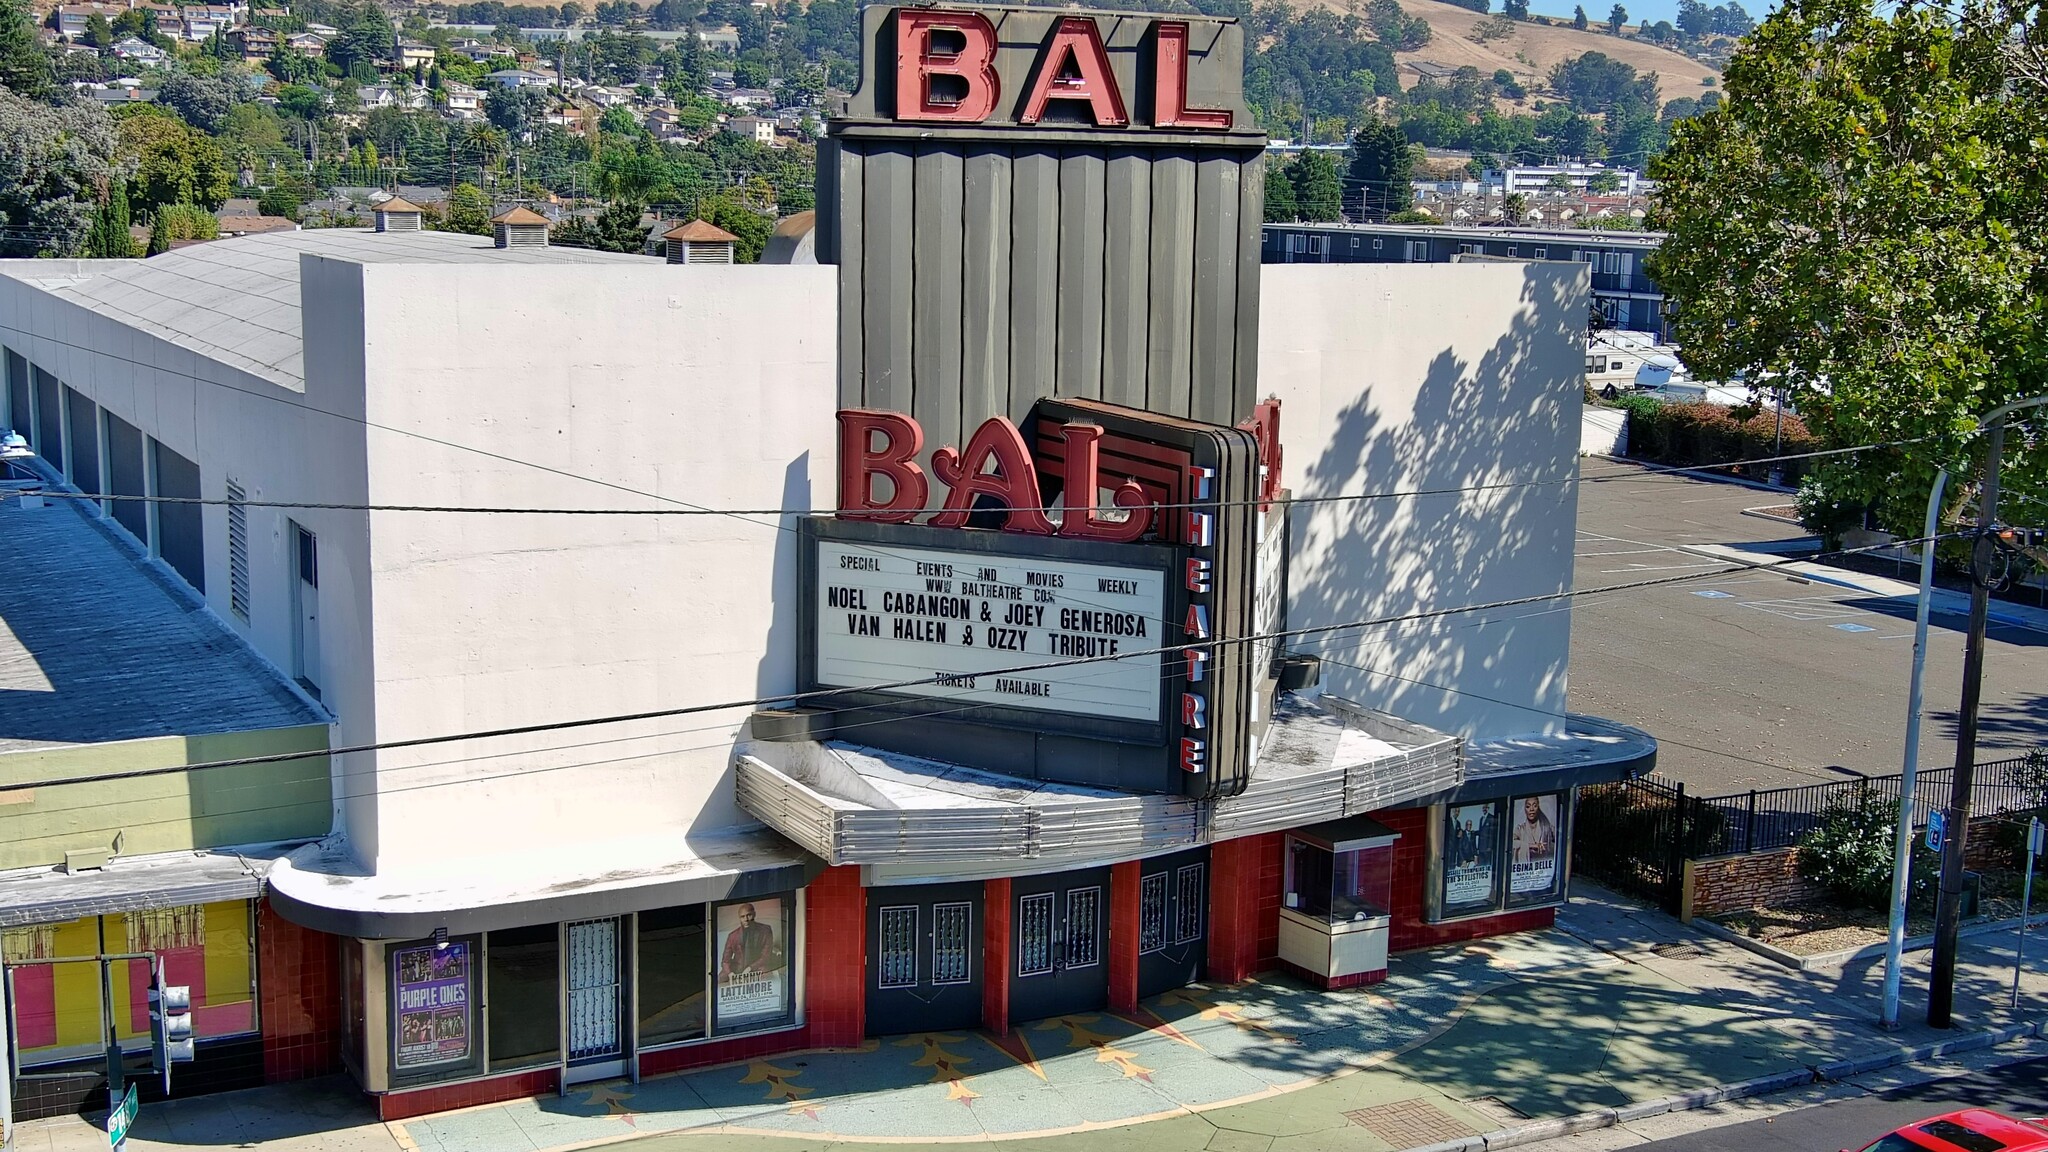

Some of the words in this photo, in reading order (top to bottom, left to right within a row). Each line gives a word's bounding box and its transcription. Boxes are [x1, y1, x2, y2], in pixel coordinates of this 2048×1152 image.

[897, 8, 1233, 128] BAL
[836, 410, 1154, 542] BAL
[840, 555, 880, 571] SPECIAL
[917, 561, 953, 578] EVENTS
[977, 567, 997, 582] AND
[1026, 571, 1064, 588] MOVIES
[1098, 578, 1138, 595] WEEKLY
[962, 582, 1022, 600] BALTHEATRE
[828, 586, 867, 610] NOEL
[883, 591, 970, 619] CABANGON
[980, 601, 992, 622] &
[1004, 603, 1045, 627] JOEY
[1060, 607, 1147, 637] GENEROSA
[1180, 466, 1214, 773] THEATRE
[847, 613, 880, 637] VAN
[893, 617, 947, 643] HALEN
[987, 626, 1028, 651] OZZY
[1048, 633, 1118, 660] TRIBUTE
[935, 672, 976, 689] TICKETS
[995, 678, 1050, 697] AVAILABLE
[1457, 872, 1489, 882] STYLISTICS
[1534, 860, 1553, 871] BELLE
[721, 981, 773, 998] LATTIMORE
[731, 971, 761, 985] KENNY
[400, 986, 437, 1010] PURPLE
[440, 983, 466, 1005] ONES
